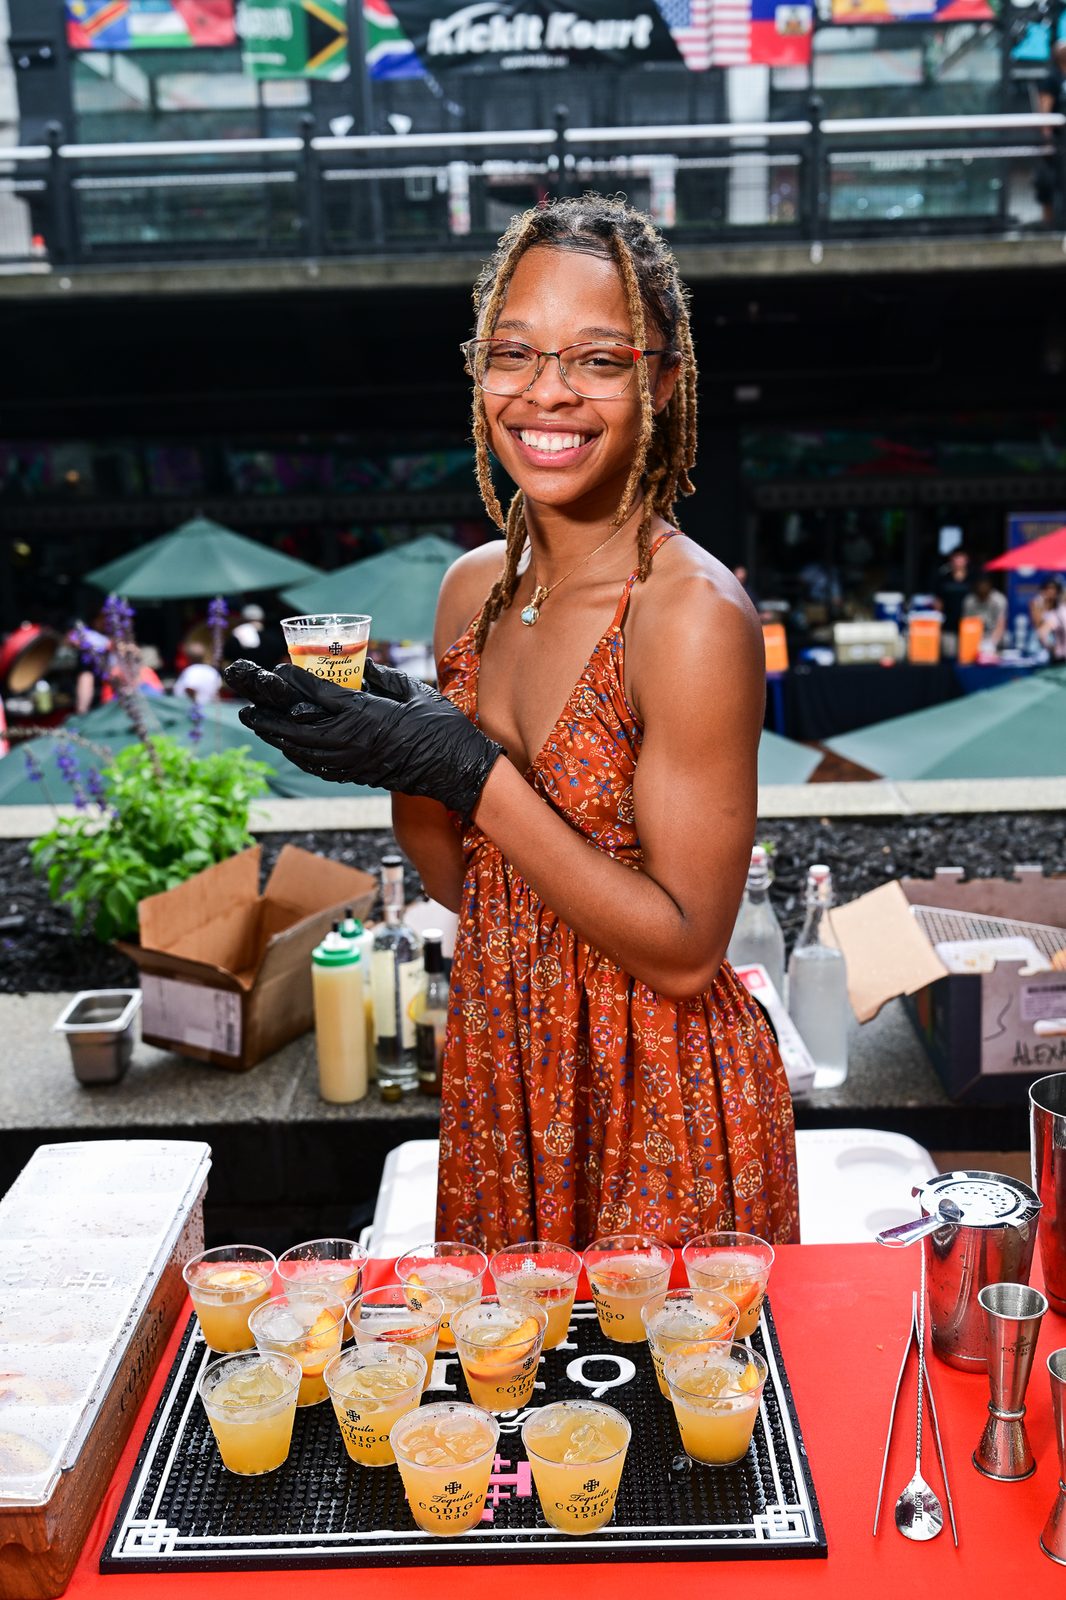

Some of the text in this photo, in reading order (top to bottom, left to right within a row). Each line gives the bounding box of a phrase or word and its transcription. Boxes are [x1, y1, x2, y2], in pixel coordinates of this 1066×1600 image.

[545, 12, 653, 49] Kourt
[317, 656, 352, 669] Tequila
[418, 1494, 483, 1514] CÓDIGO
[431, 1490, 473, 1508] Tequila
[555, 1489, 616, 1513] CÓDIGO
[568, 1487, 609, 1506] Tequila
[437, 1511, 468, 1521] 1530
[574, 1507, 604, 1519] 1530
